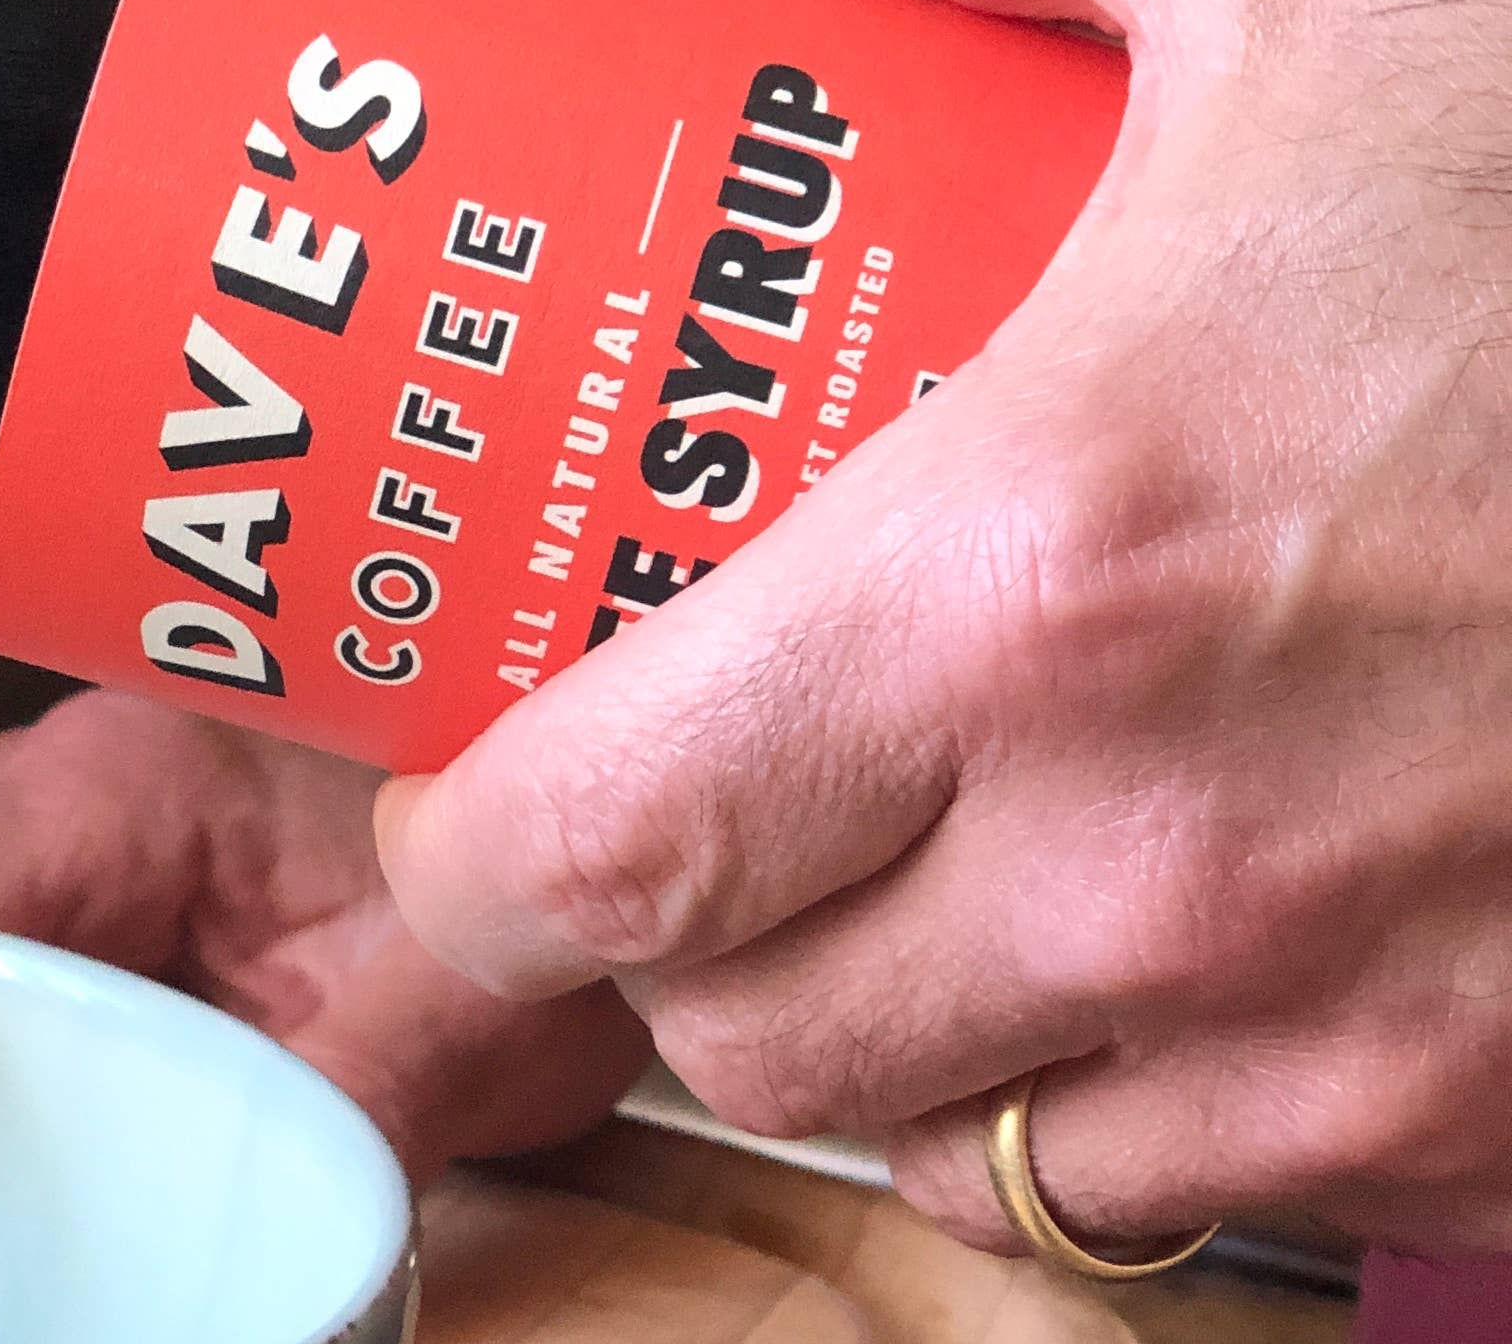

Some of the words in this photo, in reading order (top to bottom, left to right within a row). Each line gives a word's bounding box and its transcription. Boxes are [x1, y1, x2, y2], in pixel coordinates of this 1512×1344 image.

[140, 33, 427, 697] DAVE'S
[334, 198, 547, 686] COFFEE
[496, 608, 557, 692] ALL
[527, 289, 651, 581] NATURAL
[640, 64, 860, 523] SYRUP
[817, 246, 894, 429] ROASTED
